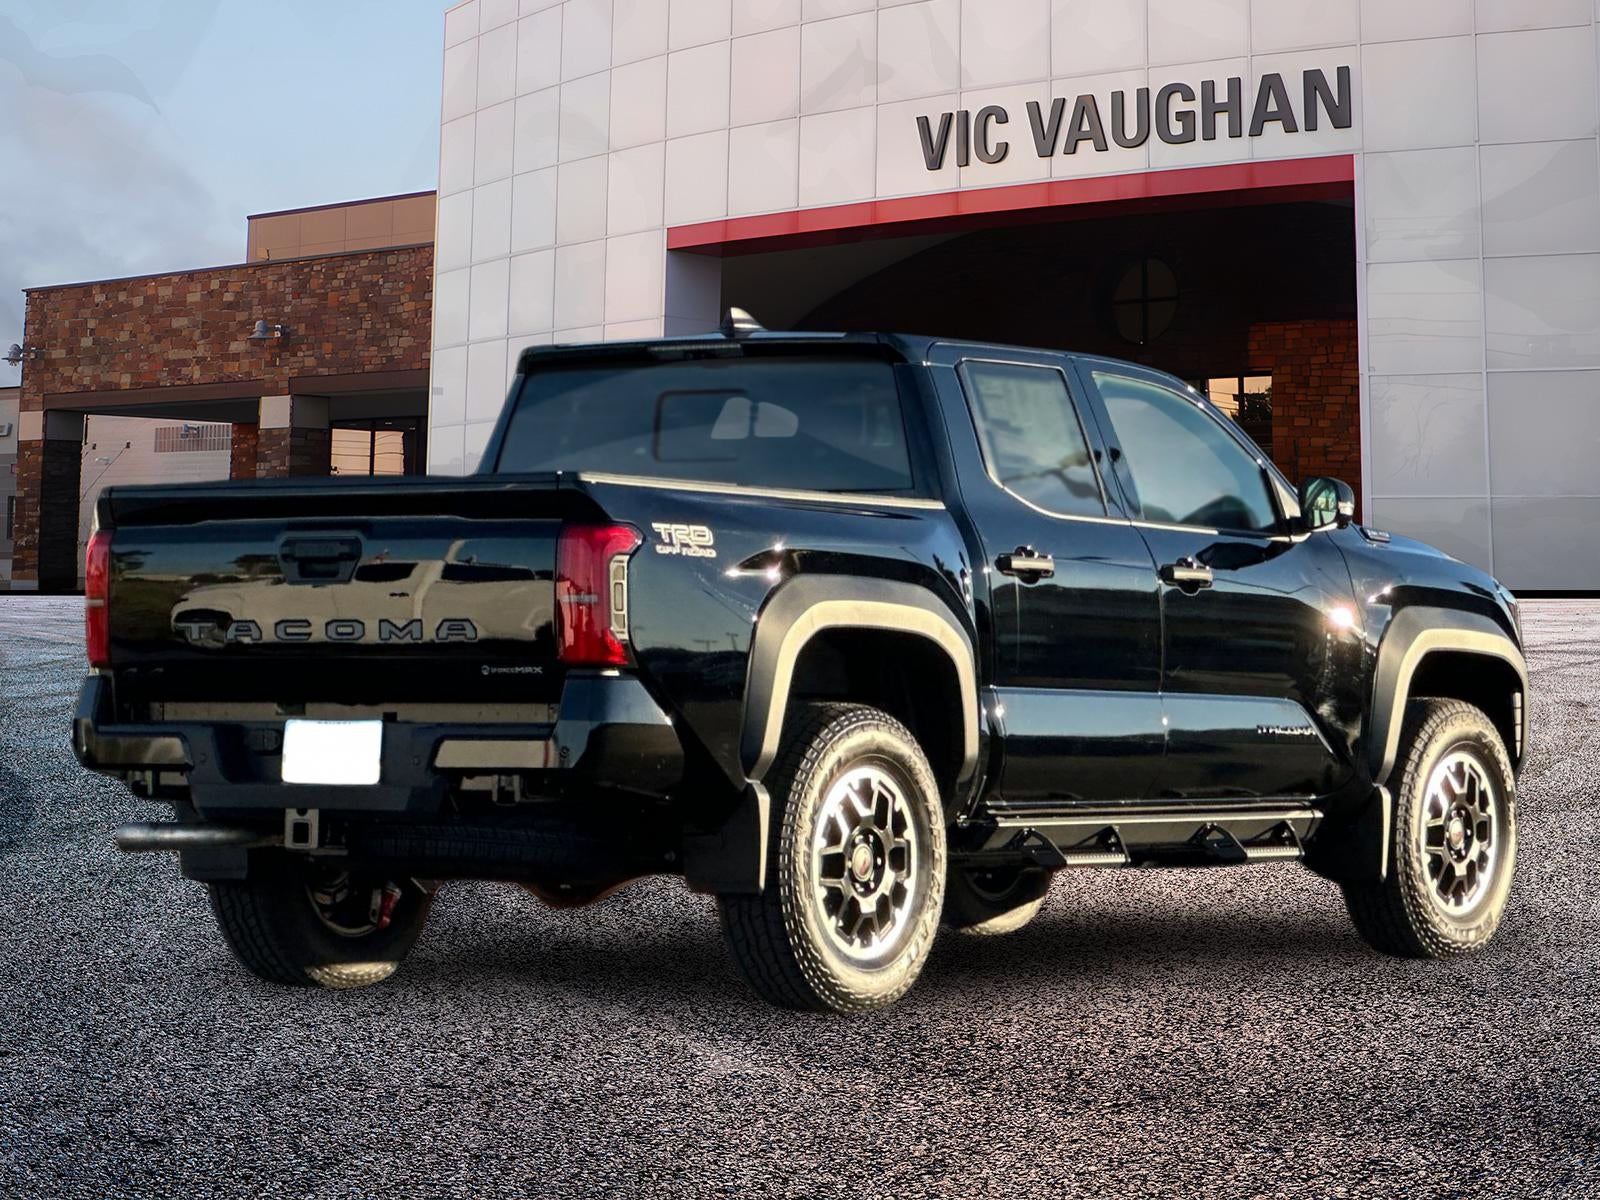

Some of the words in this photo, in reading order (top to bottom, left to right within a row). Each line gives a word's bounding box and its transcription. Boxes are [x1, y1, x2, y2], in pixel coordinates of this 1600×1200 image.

[915, 104, 1009, 171] VIC
[1025, 65, 1353, 158] VAUGHAN
[651, 522, 714, 546] TRD
[177, 618, 479, 643] TACOMA
